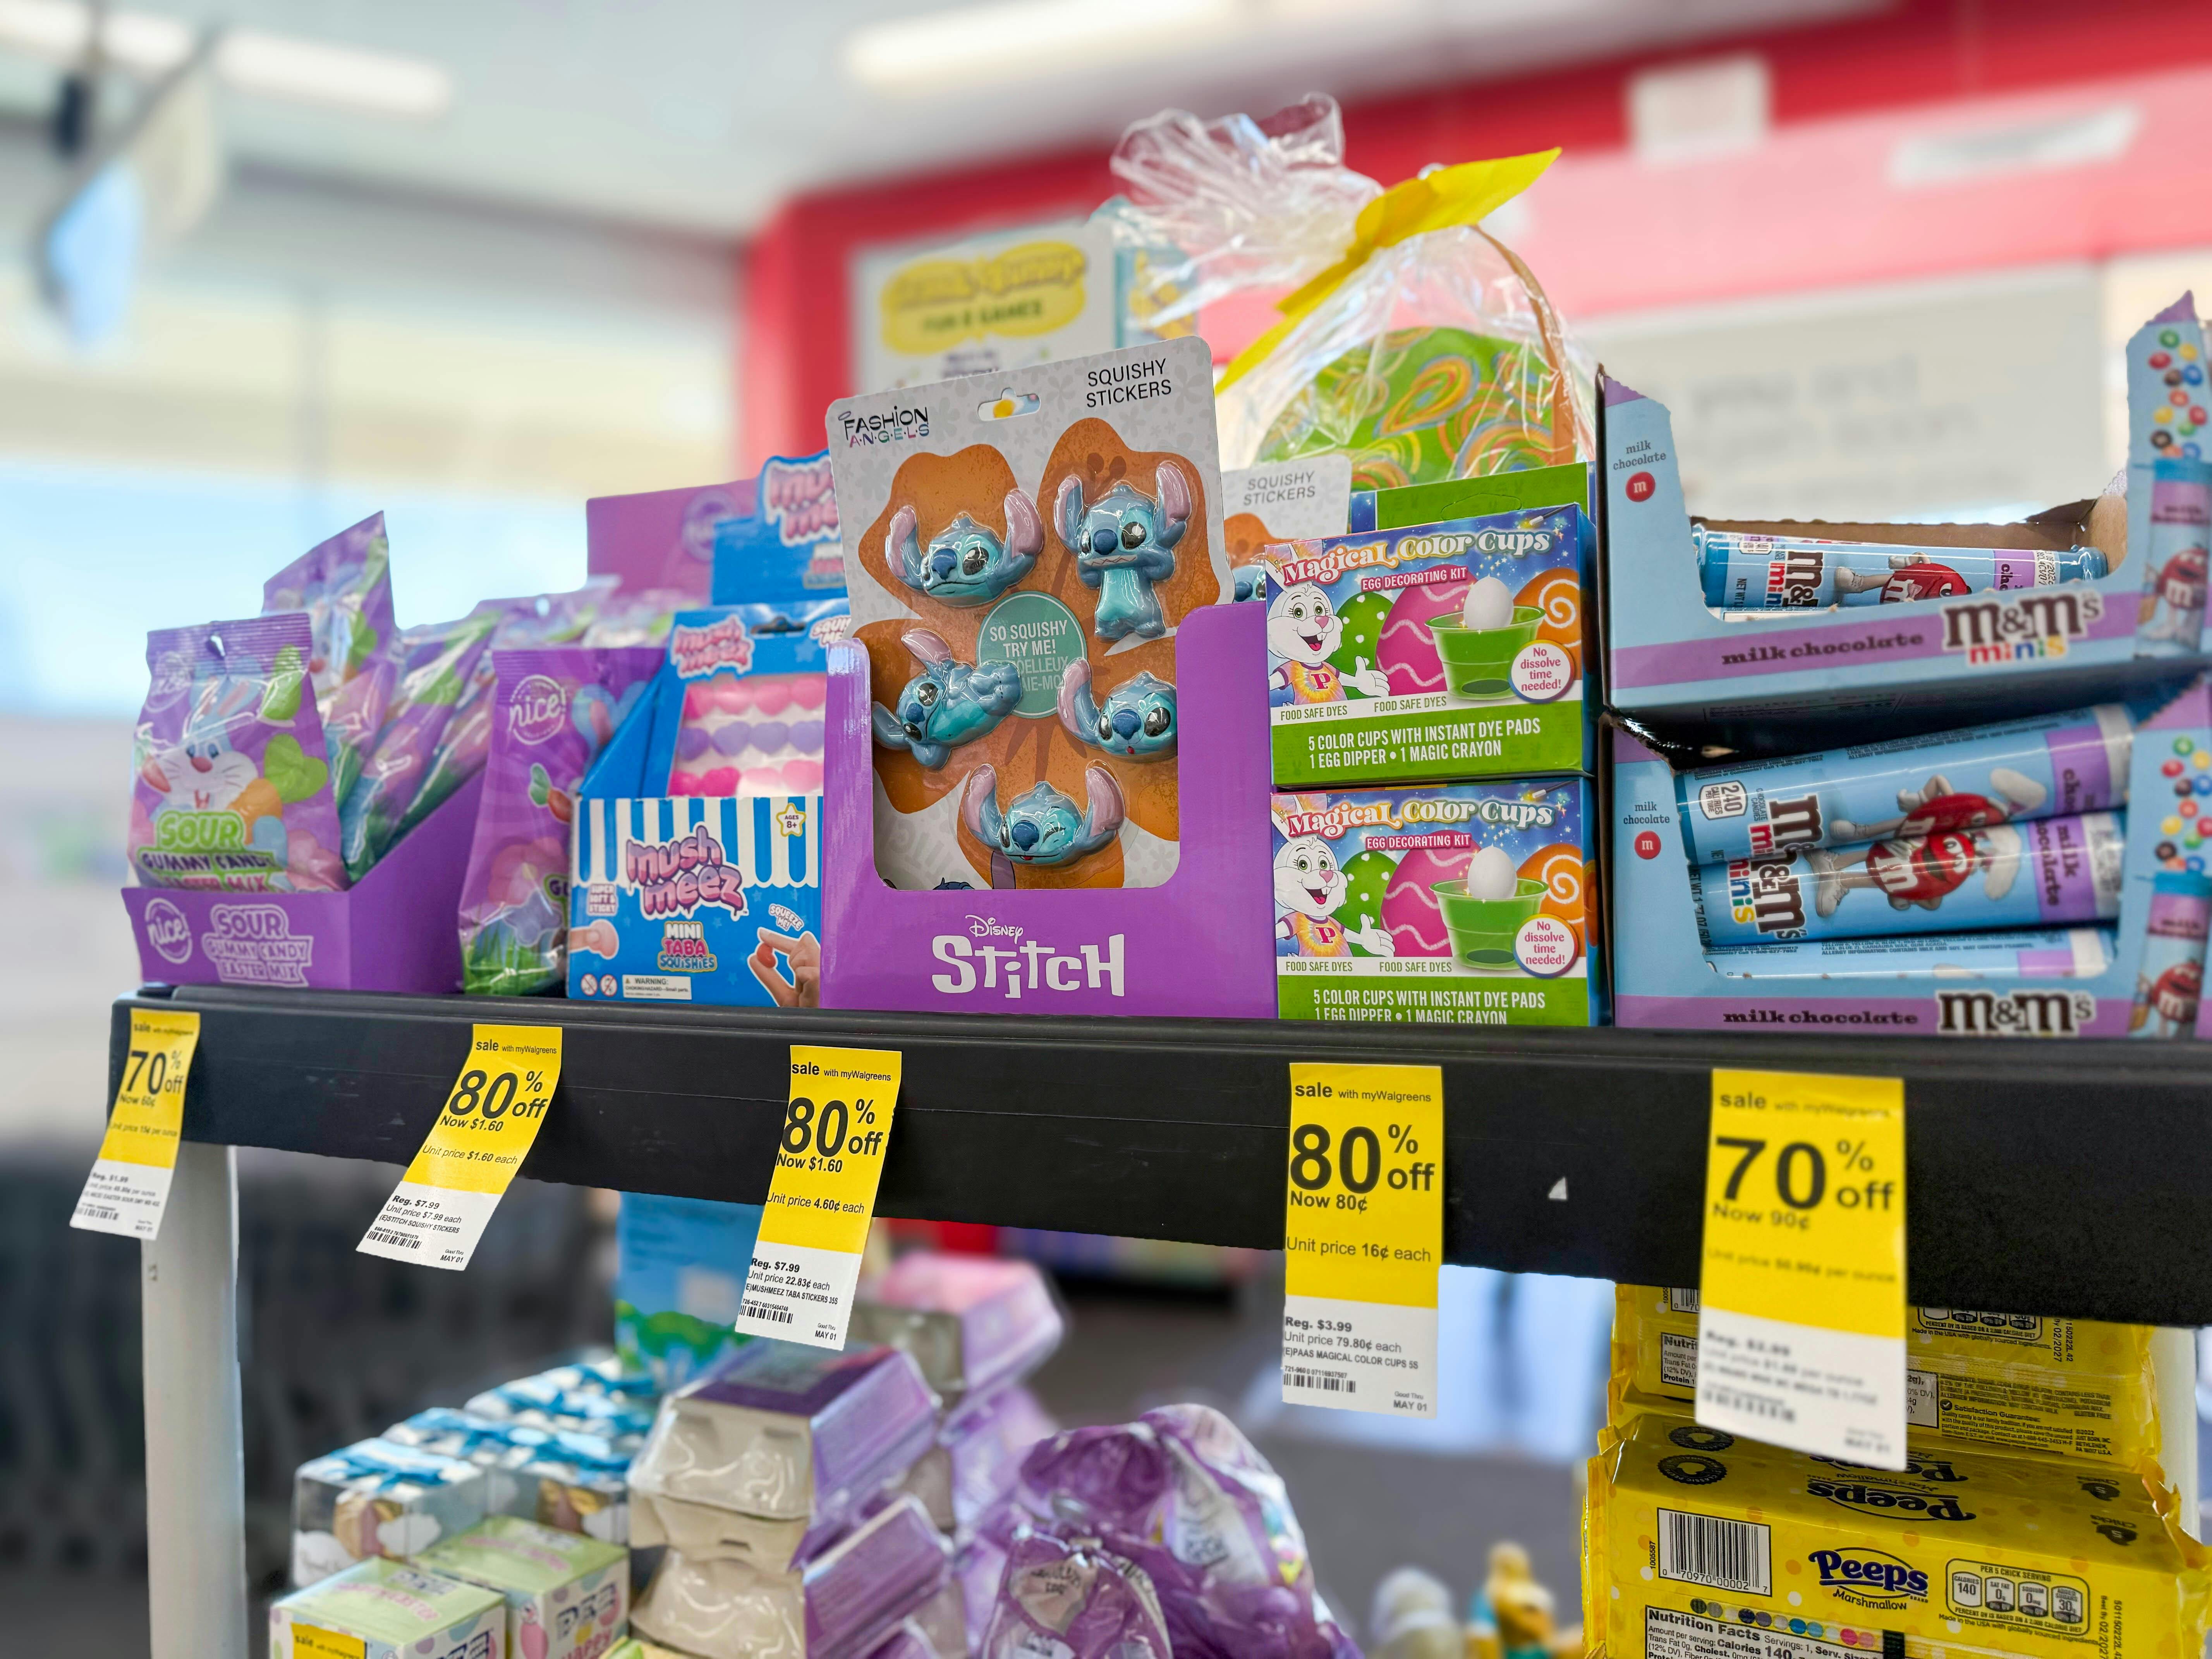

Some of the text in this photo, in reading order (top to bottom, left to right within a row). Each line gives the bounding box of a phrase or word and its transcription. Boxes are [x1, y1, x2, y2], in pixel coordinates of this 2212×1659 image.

[1088, 359, 1166, 386] SQUISHY
[1086, 379, 1171, 408] STICKERS
[1626, 440, 1651, 454] milk
[1613, 451, 1666, 471] chocolate
[1247, 471, 1315, 491] SQUISHY
[1634, 481, 1646, 493] m
[1243, 486, 1315, 506] STICKERS
[1285, 532, 1550, 583] Magical Color Cups
[1363, 568, 1467, 590] EGG DECORATING KIT
[990, 620, 1067, 642] SO SQUISHY
[1003, 639, 1056, 658] TRY ME!
[1533, 647, 1547, 657] No
[1722, 634, 1923, 665] milk chocolate
[1969, 635, 2068, 665] minis
[1521, 657, 1561, 669] dissolve
[1312, 673, 1331, 690] P
[1530, 670, 1552, 679] time
[1522, 679, 1561, 691] needed!
[1281, 706, 1348, 721] FOOD SAFE DYES
[1374, 696, 1447, 712] FOOD SAFE DYES
[1309, 718, 1540, 751] 5 COLOR CUPS WITH INSTANT DYE PADS
[1310, 740, 1501, 768] 1 EGG DIPPER 1 MAGIC CRAYON
[1635, 802, 1657, 812] milk
[1720, 785, 1743, 812] 240
[1289, 800, 1553, 838] Magical Color Cups
[1751, 797, 1761, 821] CANDIES
[1623, 814, 1670, 825] chocolate
[160, 812, 241, 850] SOUR
[1367, 834, 1470, 849] EGG DECORATING KIT
[1642, 840, 1653, 849] m
[2057, 824, 2080, 877] milk
[140, 853, 211, 871] GUMMY
[626, 824, 722, 886] mush
[644, 865, 744, 915] meez
[215, 910, 282, 938] SOUR
[769, 905, 802, 929] SQUEEZE
[776, 915, 790, 929] ME!
[666, 924, 701, 939] MINI
[664, 940, 706, 955] TABA
[1724, 1010, 1918, 1025] milk chocolate
[476, 1039, 499, 1051] sale
[516, 1046, 557, 1054] myWalgreens
[127, 1050, 184, 1095] 70 % off
[120, 1094, 139, 1104] Now
[449, 1070, 548, 1119] 80 % off
[1295, 1082, 1431, 1102] sale with myWalgreens
[1720, 1092, 1766, 1109] sale
[440, 1115, 504, 1132] Now $1.60
[782, 1097, 883, 1158] 80 % off
[422, 1145, 517, 1164] Unit price $1.60 each
[776, 1153, 843, 1173] Now $1.60
[1290, 1124, 1435, 1194] 80 % off
[1715, 1135, 1896, 1211] 70 % off
[1290, 1191, 1368, 1214] Now 80¢
[1713, 1202, 1762, 1223] Now
[379, 1214, 460, 1233] (E)STITCH SQUISHY STICKERS
[751, 1258, 800, 1273] Reg. $7.99
[764, 1274, 783, 1283] price
[785, 1276, 811, 1289] 22.83¢
[813, 1281, 830, 1291] each
[786, 1289, 800, 1299] TABA
[802, 1293, 828, 1303] STICKERS
[1316, 1350, 1352, 1362] MAGICAL
[1355, 1355, 1382, 1365] COLOR
[1384, 1358, 1407, 1368] CUPS
[1408, 1360, 1418, 1369] 5S
[1664, 1373, 1689, 1384] Protein
[1806, 1482, 1977, 1521] Peeps
[1681, 1570, 1712, 1583] 70970
[1717, 1578, 1749, 1590] 00002
[1808, 1550, 1928, 1592] Peeps
[1833, 1589, 1906, 1610] Marshmallow
[1649, 1609, 1803, 1650] Nutrition Facts Servings:
[1649, 1626, 1674, 1636] Amount
[1689, 1635, 1716, 1647] serving:
[1717, 1639, 1761, 1654] Calories
